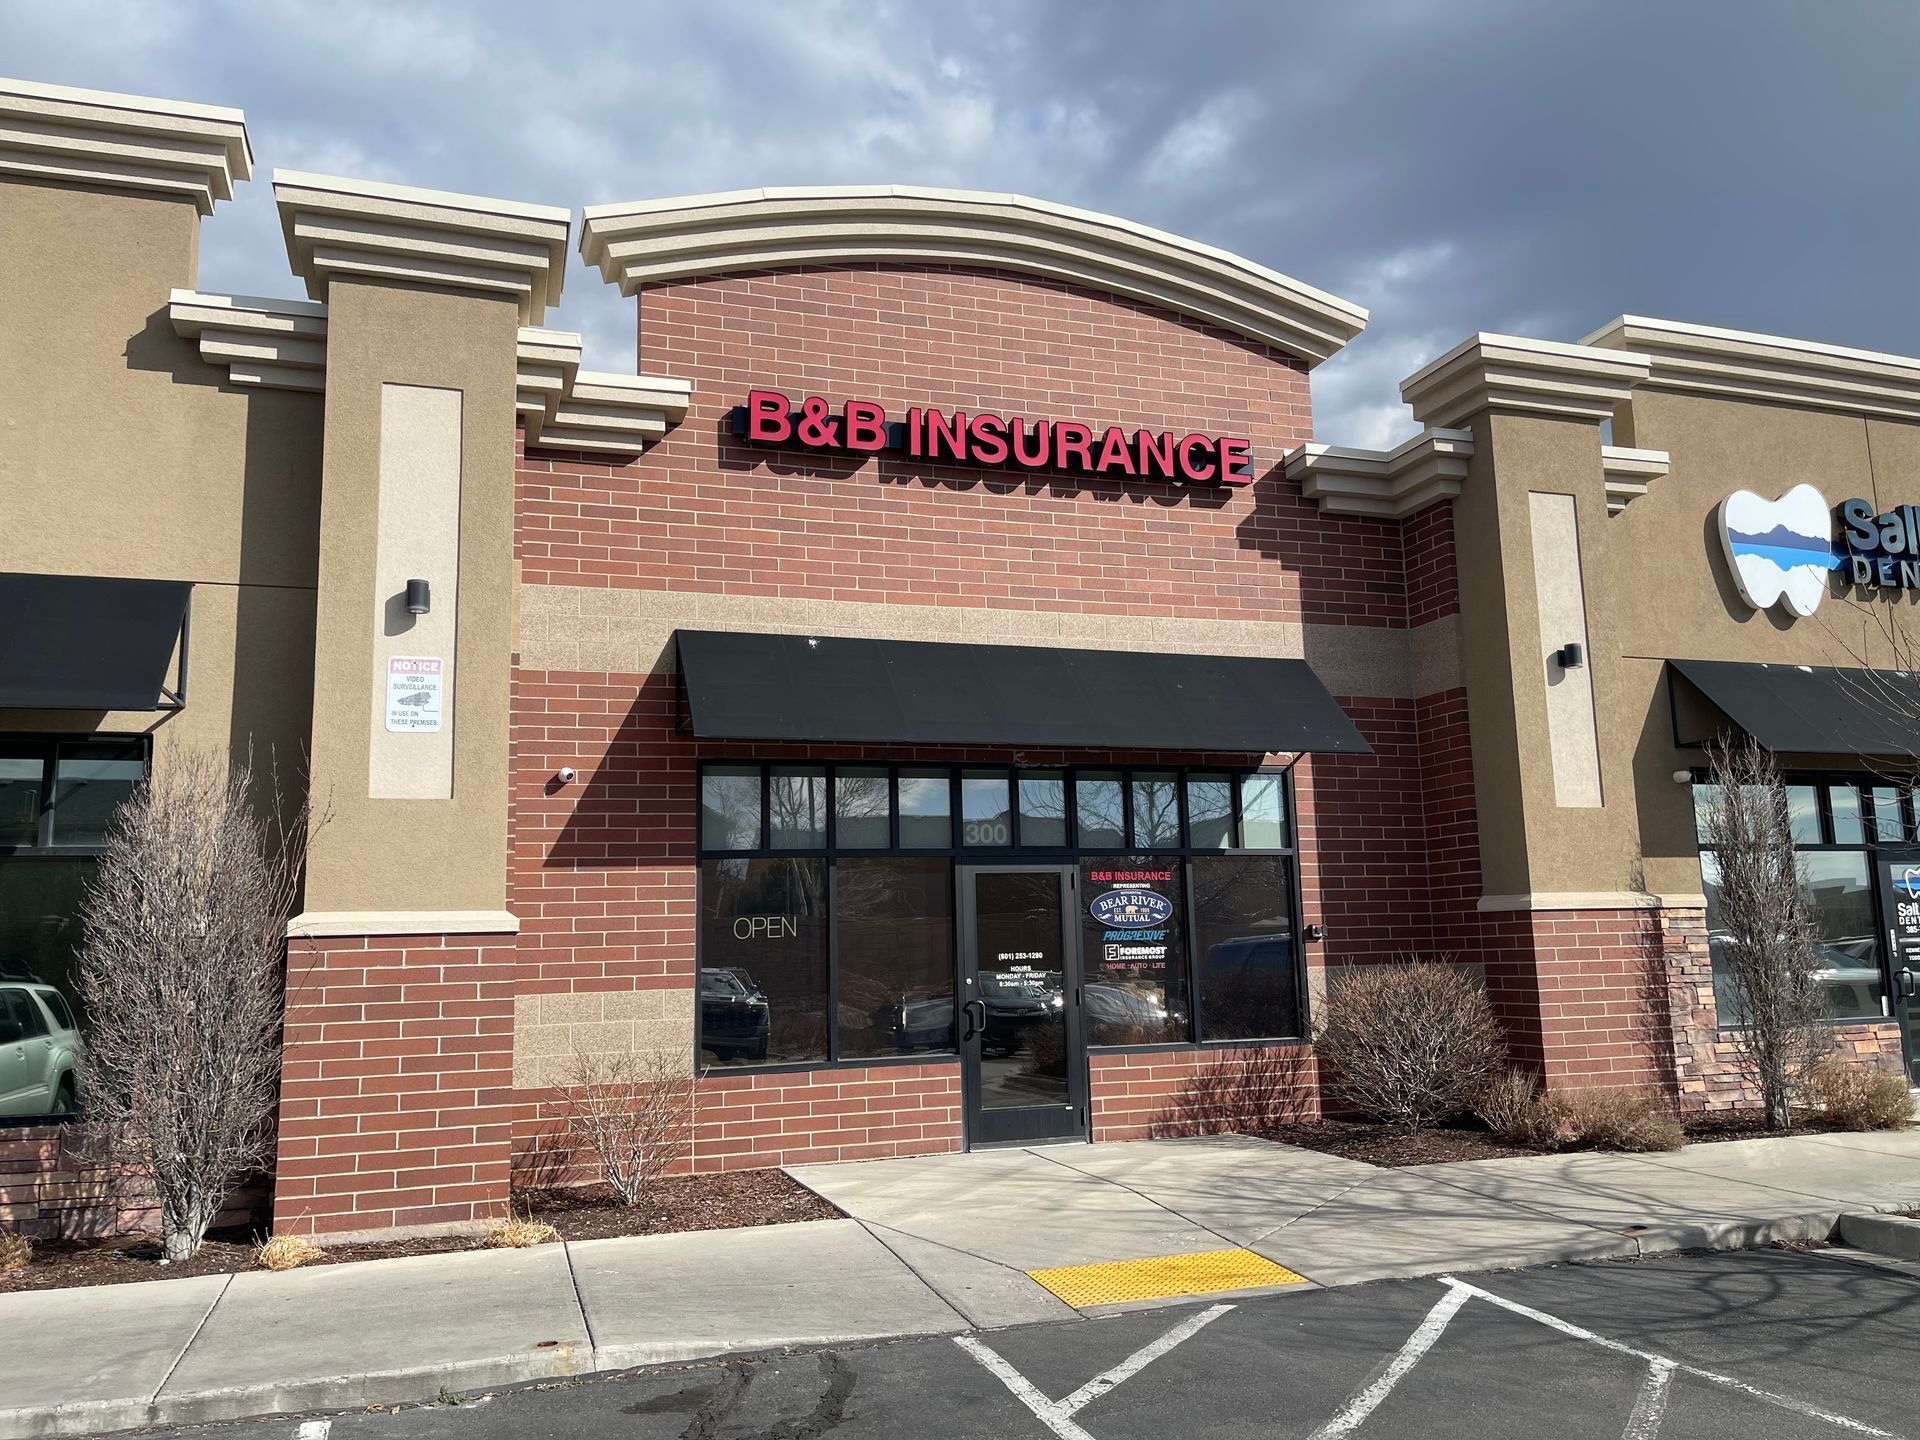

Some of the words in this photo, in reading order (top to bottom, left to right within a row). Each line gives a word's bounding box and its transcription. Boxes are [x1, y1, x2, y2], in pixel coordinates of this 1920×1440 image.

[748, 389, 888, 452] B&B
[907, 406, 1254, 485] INSURANCE
[393, 660, 439, 672] NOTICE
[965, 823, 1008, 844] 300
[1091, 871, 1112, 880] B&B
[1114, 871, 1172, 880] INSURANCE
[1100, 896, 1129, 911] BEAR
[1131, 895, 1164, 911] RIVER
[1114, 914, 1151, 922] MUTUAL
[733, 915, 797, 940] OPEN
[1103, 930, 1165, 941] PROGRESSIVE
[1120, 947, 1166, 955] FOREMOST
[999, 953, 1014, 961] (801)
